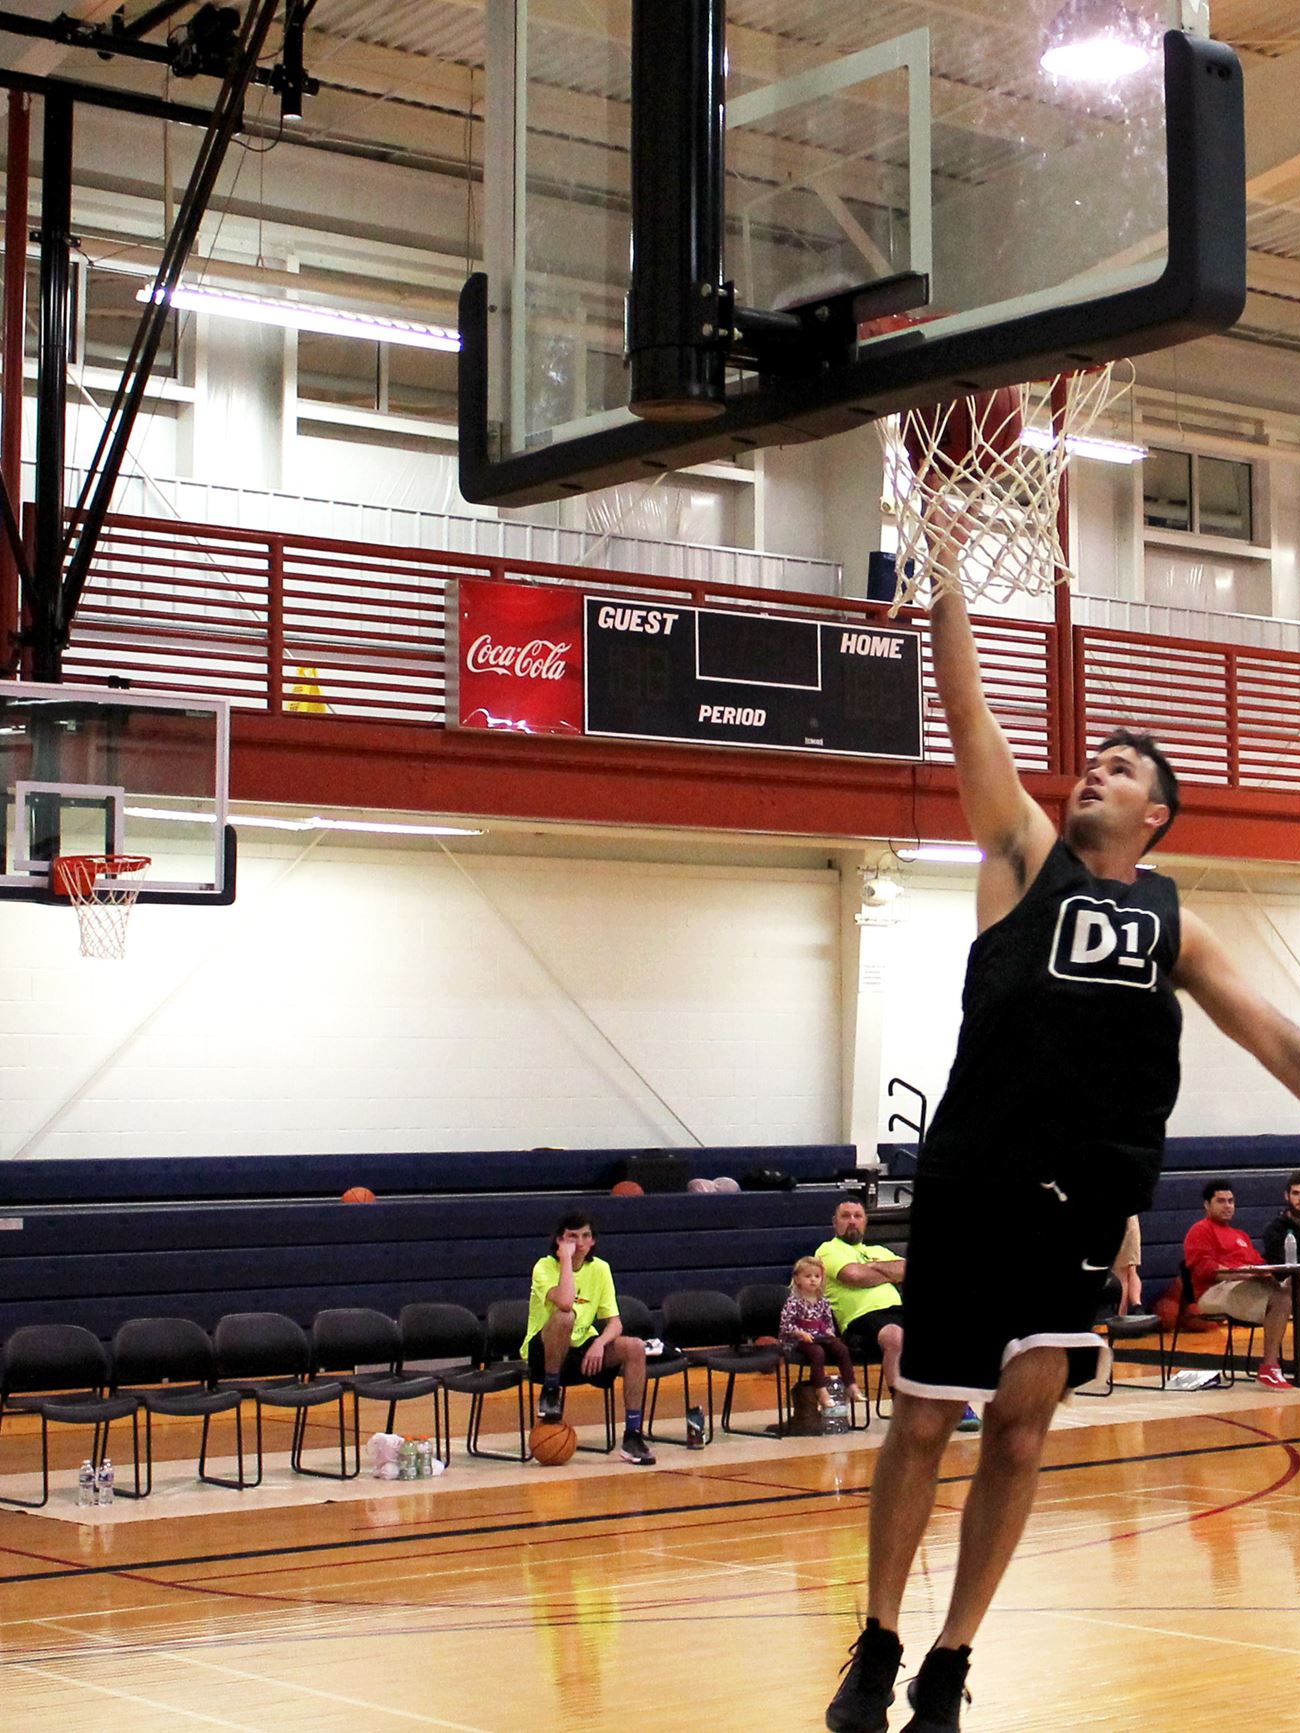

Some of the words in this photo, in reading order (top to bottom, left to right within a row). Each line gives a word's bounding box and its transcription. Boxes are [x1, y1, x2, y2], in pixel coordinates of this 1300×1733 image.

[598, 606, 679, 635] GUEST
[467, 634, 572, 680] Coca-Cola
[840, 632, 904, 659] HOME
[698, 704, 766, 727] PERIOD
[1070, 910, 1141, 965] D1
